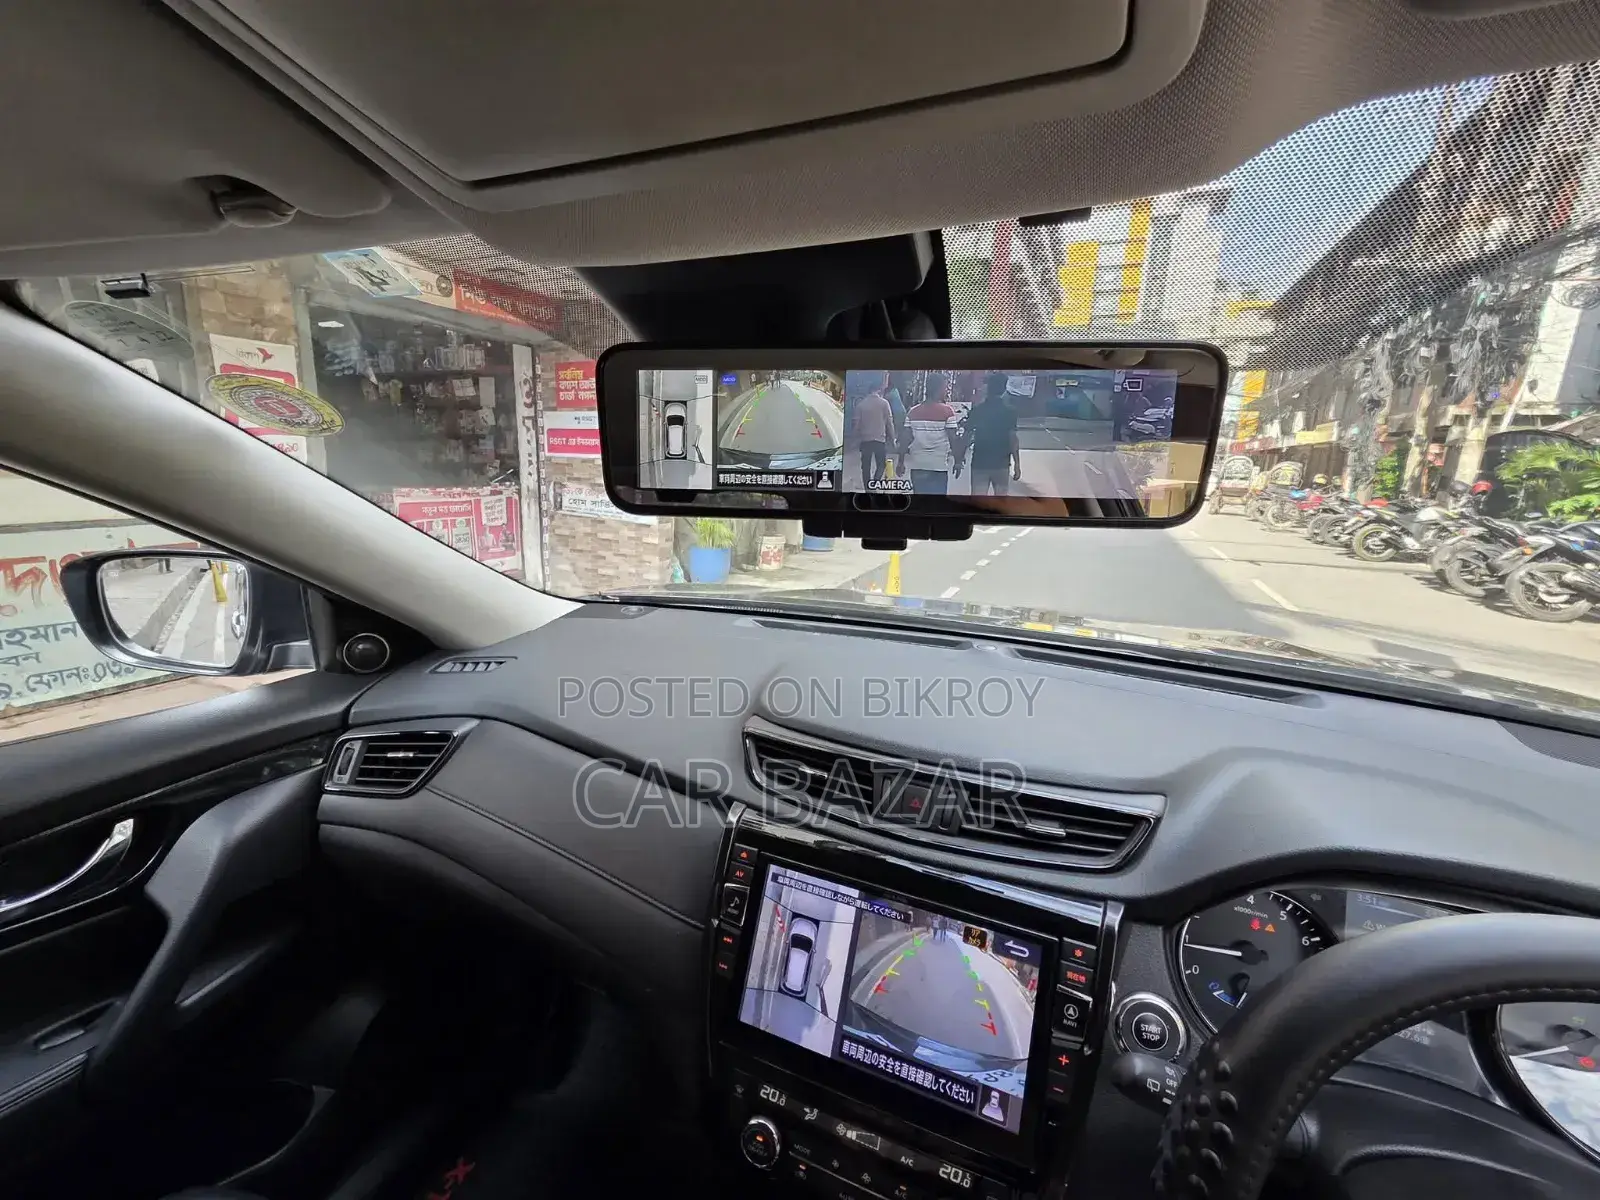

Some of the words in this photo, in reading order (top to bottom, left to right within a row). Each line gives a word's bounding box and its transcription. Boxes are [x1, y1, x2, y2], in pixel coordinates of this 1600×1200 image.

[579, 378, 596, 390] আউ
[868, 480, 911, 490] CAMERA
[0, 621, 77, 650] হমান
[1246, 895, 1255, 904] 4
[1279, 911, 1287, 921] 5
[1301, 936, 1310, 946] 6
[1192, 965, 1200, 974] 0
[1063, 1018, 1077, 1028] NAVI
[1140, 1023, 1162, 1034] START
[1142, 1031, 1160, 1042] STOP
[841, 1039, 974, 1104] 車両周辺の安全を直接確認してください
[1165, 1077, 1178, 1088] OFF
[900, 1156, 914, 1167] A/C
